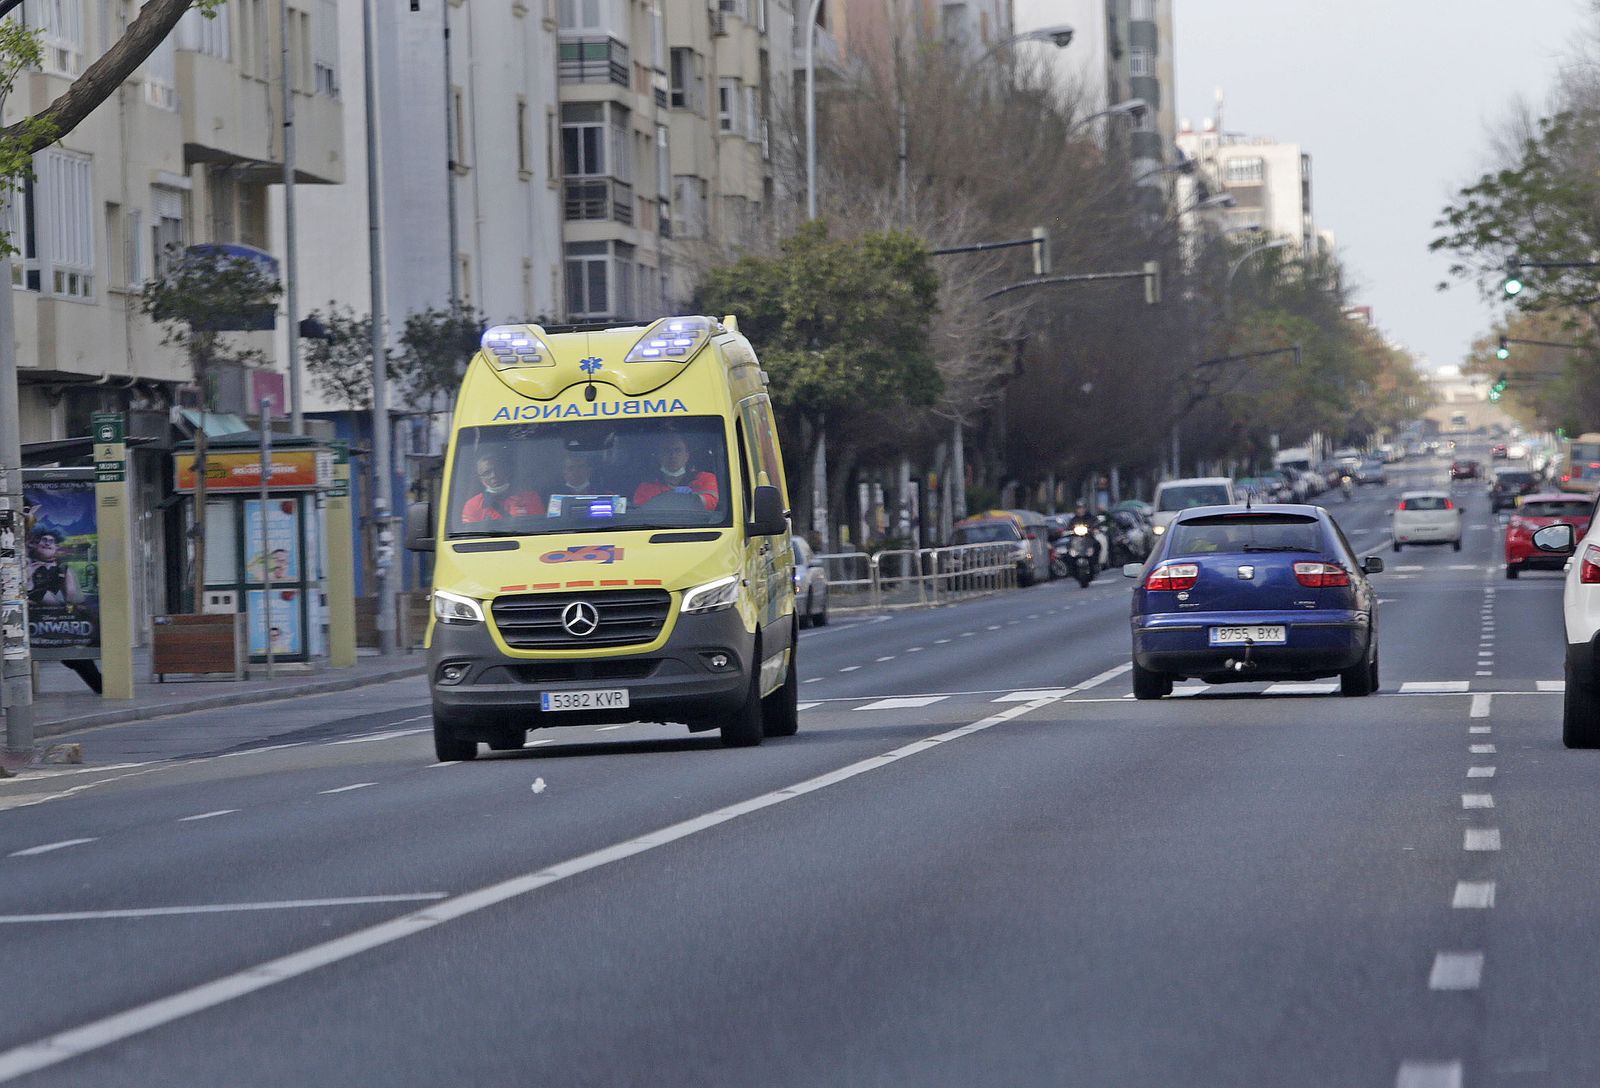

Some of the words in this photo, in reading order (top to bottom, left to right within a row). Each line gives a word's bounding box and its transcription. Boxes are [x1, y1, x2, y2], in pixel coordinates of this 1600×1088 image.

[539, 545, 625, 564] 061
[28, 620, 93, 636] ONWARD
[1219, 628, 1249, 639] 8755
[1259, 628, 1280, 639] BXX
[553, 693, 591, 708] 5382
[595, 691, 623, 706] KVR
